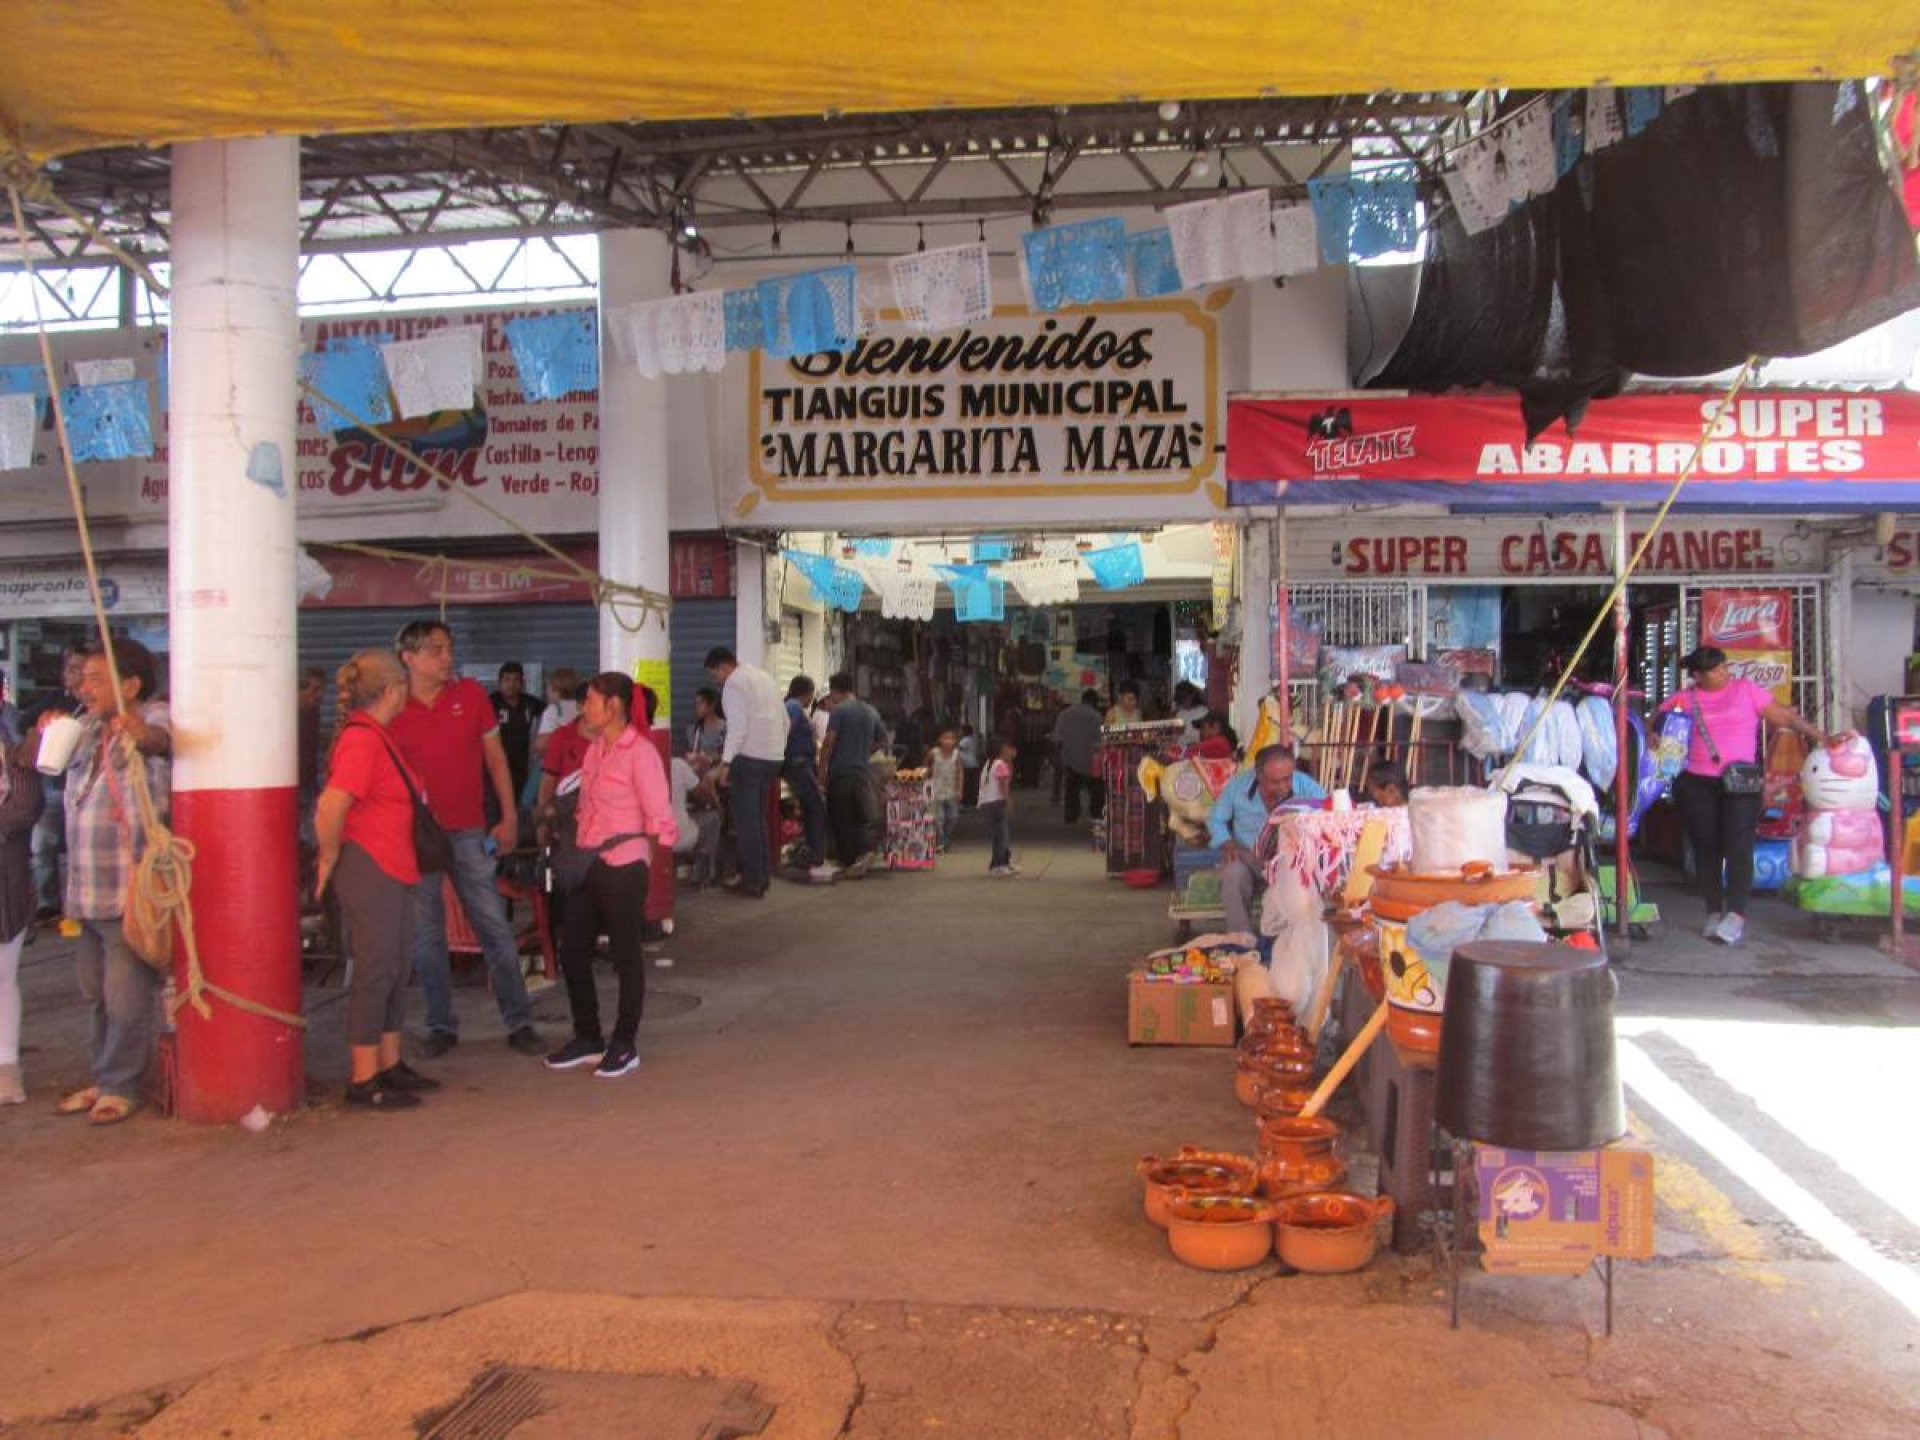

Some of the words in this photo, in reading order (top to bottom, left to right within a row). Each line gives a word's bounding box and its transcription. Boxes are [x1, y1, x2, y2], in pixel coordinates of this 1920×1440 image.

[764, 384, 945, 422] TIANGUIS
[960, 380, 1187, 417] MUNICIPAL
[1701, 398, 1883, 438] SUPER
[490, 415, 548, 434] Tamales
[556, 412, 575, 431] de
[486, 444, 541, 466] Costilla
[557, 441, 599, 465] Leng
[1306, 425, 1416, 473] TECATE
[1476, 439, 1864, 475] ABARROTES
[502, 473, 549, 494] Verde
[1344, 535, 1469, 575] SUPER
[1501, 530, 1604, 576] CASA
